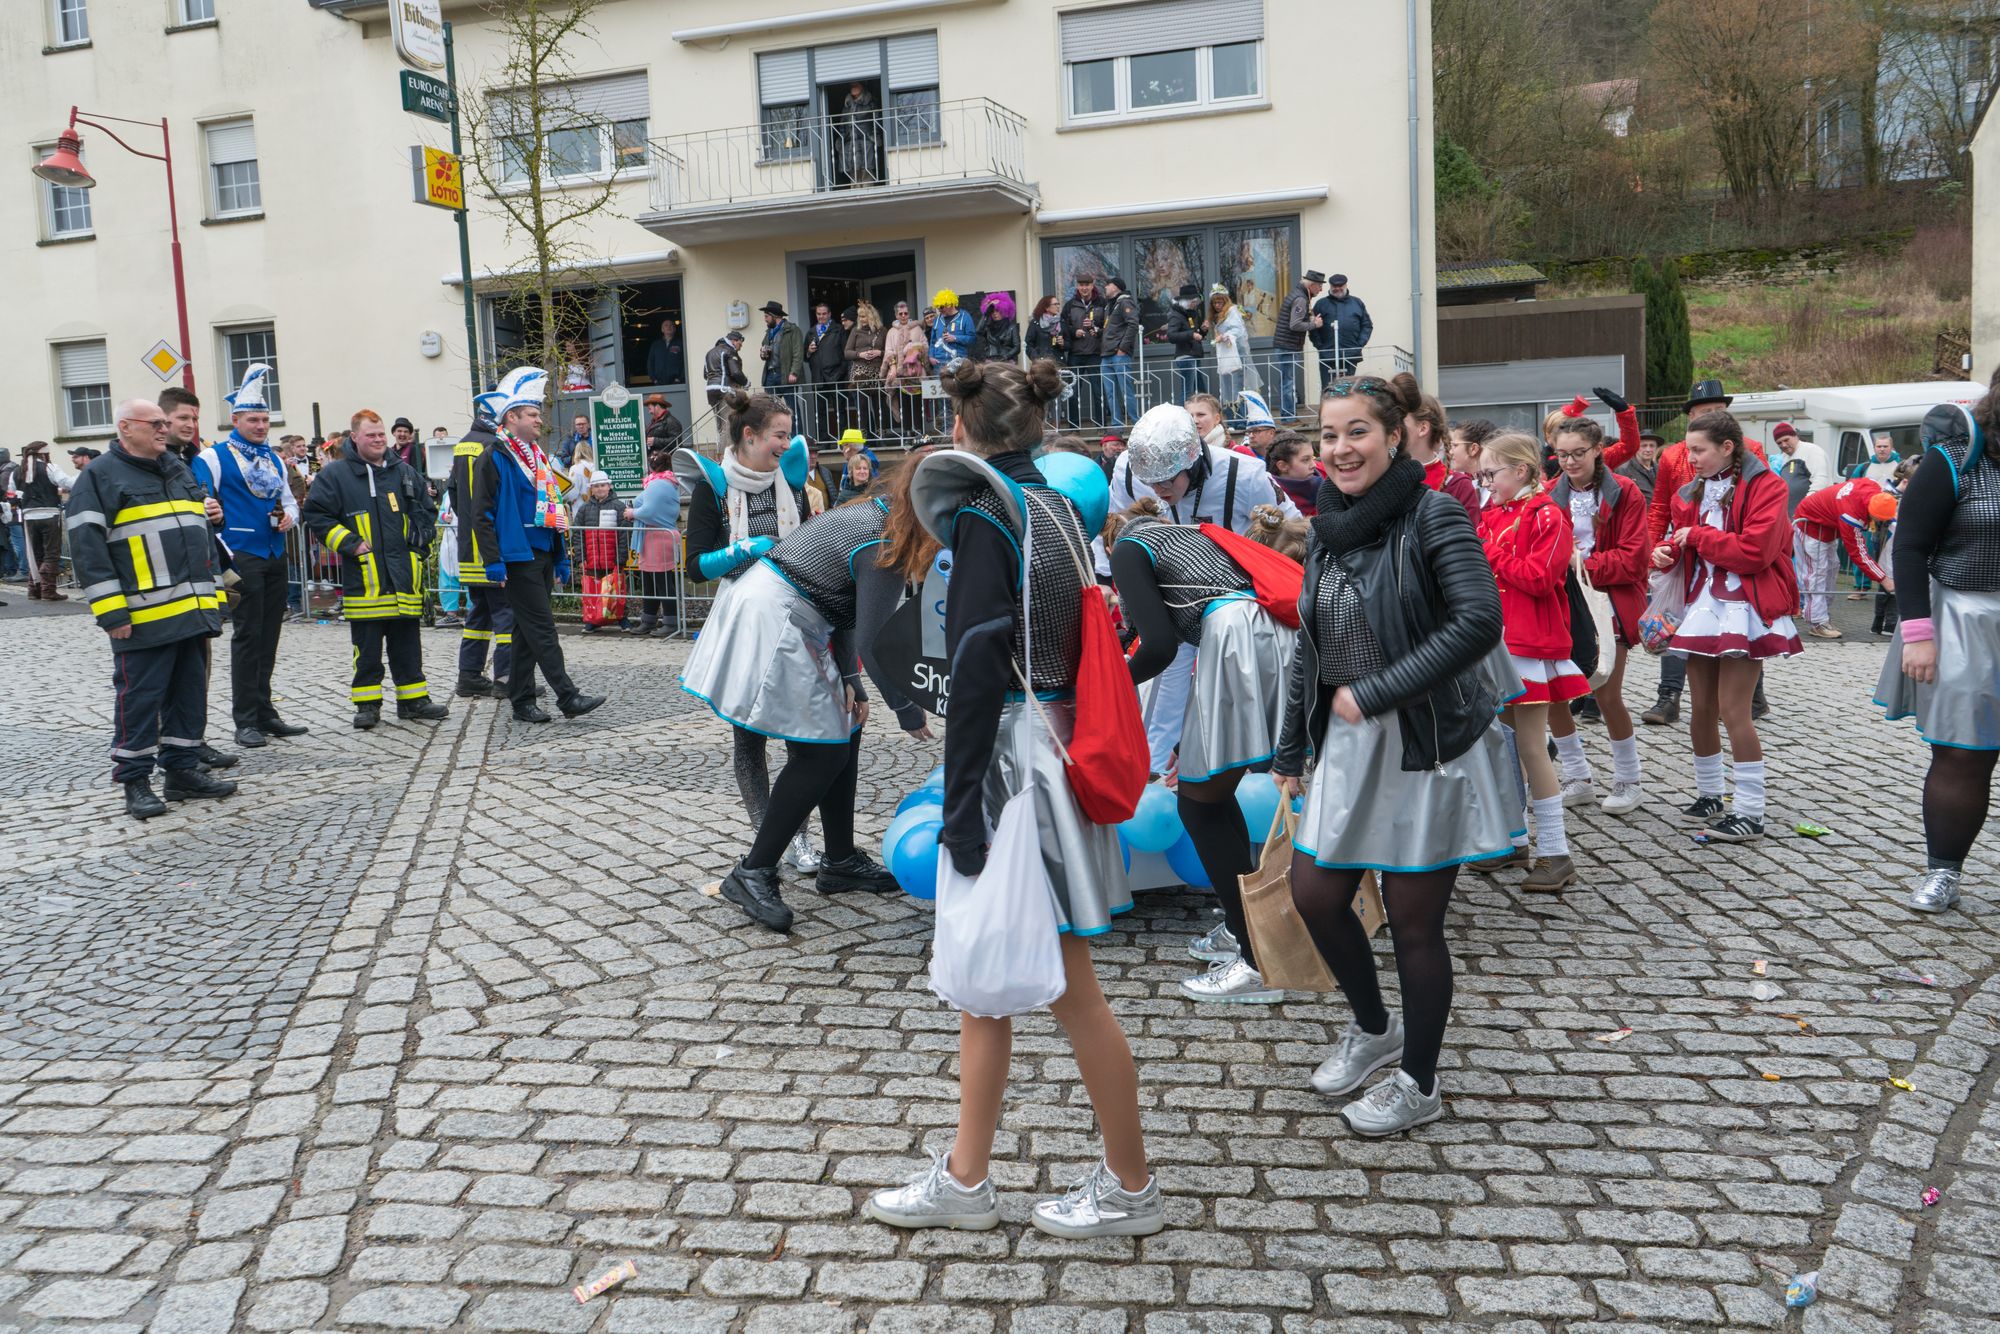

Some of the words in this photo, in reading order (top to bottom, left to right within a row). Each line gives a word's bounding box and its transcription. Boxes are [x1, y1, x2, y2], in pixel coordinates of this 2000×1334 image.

[408, 76, 432, 93] EURO
[420, 95, 443, 112] ARENS
[431, 183, 459, 203] LOTTO
